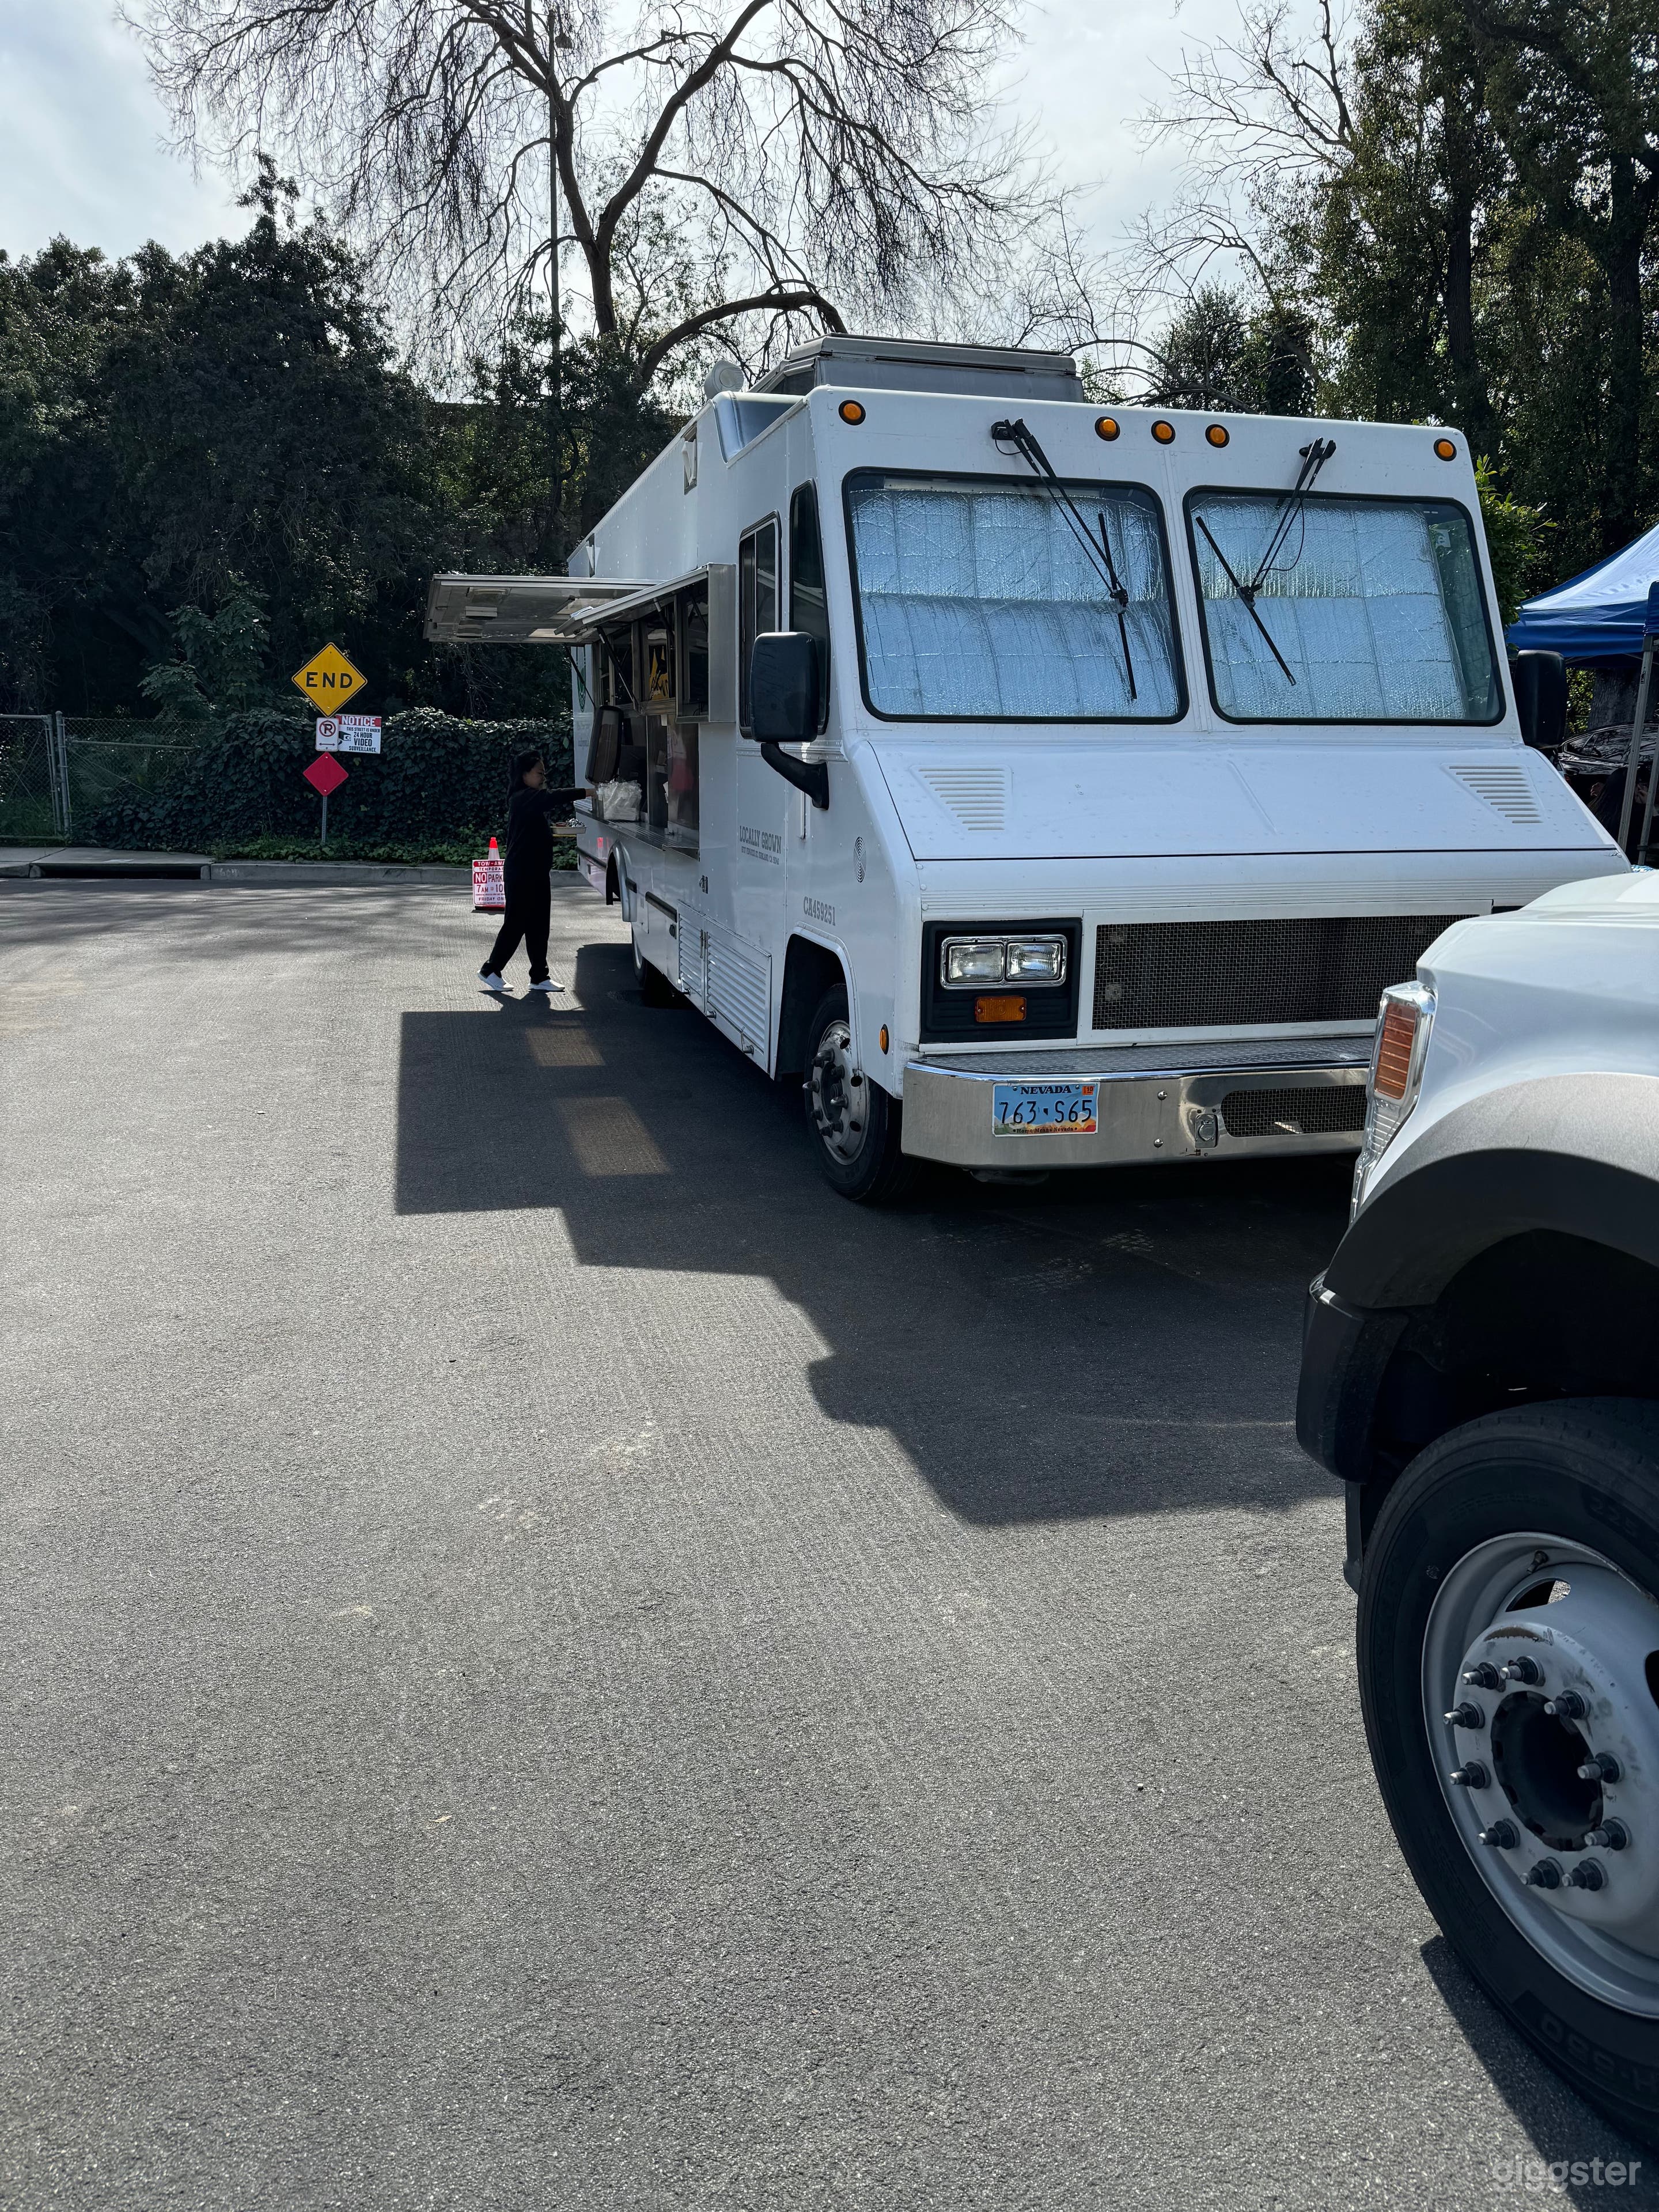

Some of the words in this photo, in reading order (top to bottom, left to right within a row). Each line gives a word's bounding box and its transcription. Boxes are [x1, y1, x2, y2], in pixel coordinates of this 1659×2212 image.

[306, 672, 353, 688] END
[342, 715, 376, 726] NOTICE
[354, 738, 372, 747] VIDEO
[740, 825, 760, 847] LOCALLY
[761, 831, 782, 854] GROWN
[475, 873, 487, 883] NO
[488, 874, 503, 882] PARK
[804, 896, 836, 926] CA459251
[1020, 1085, 1071, 1094] NEVADA
